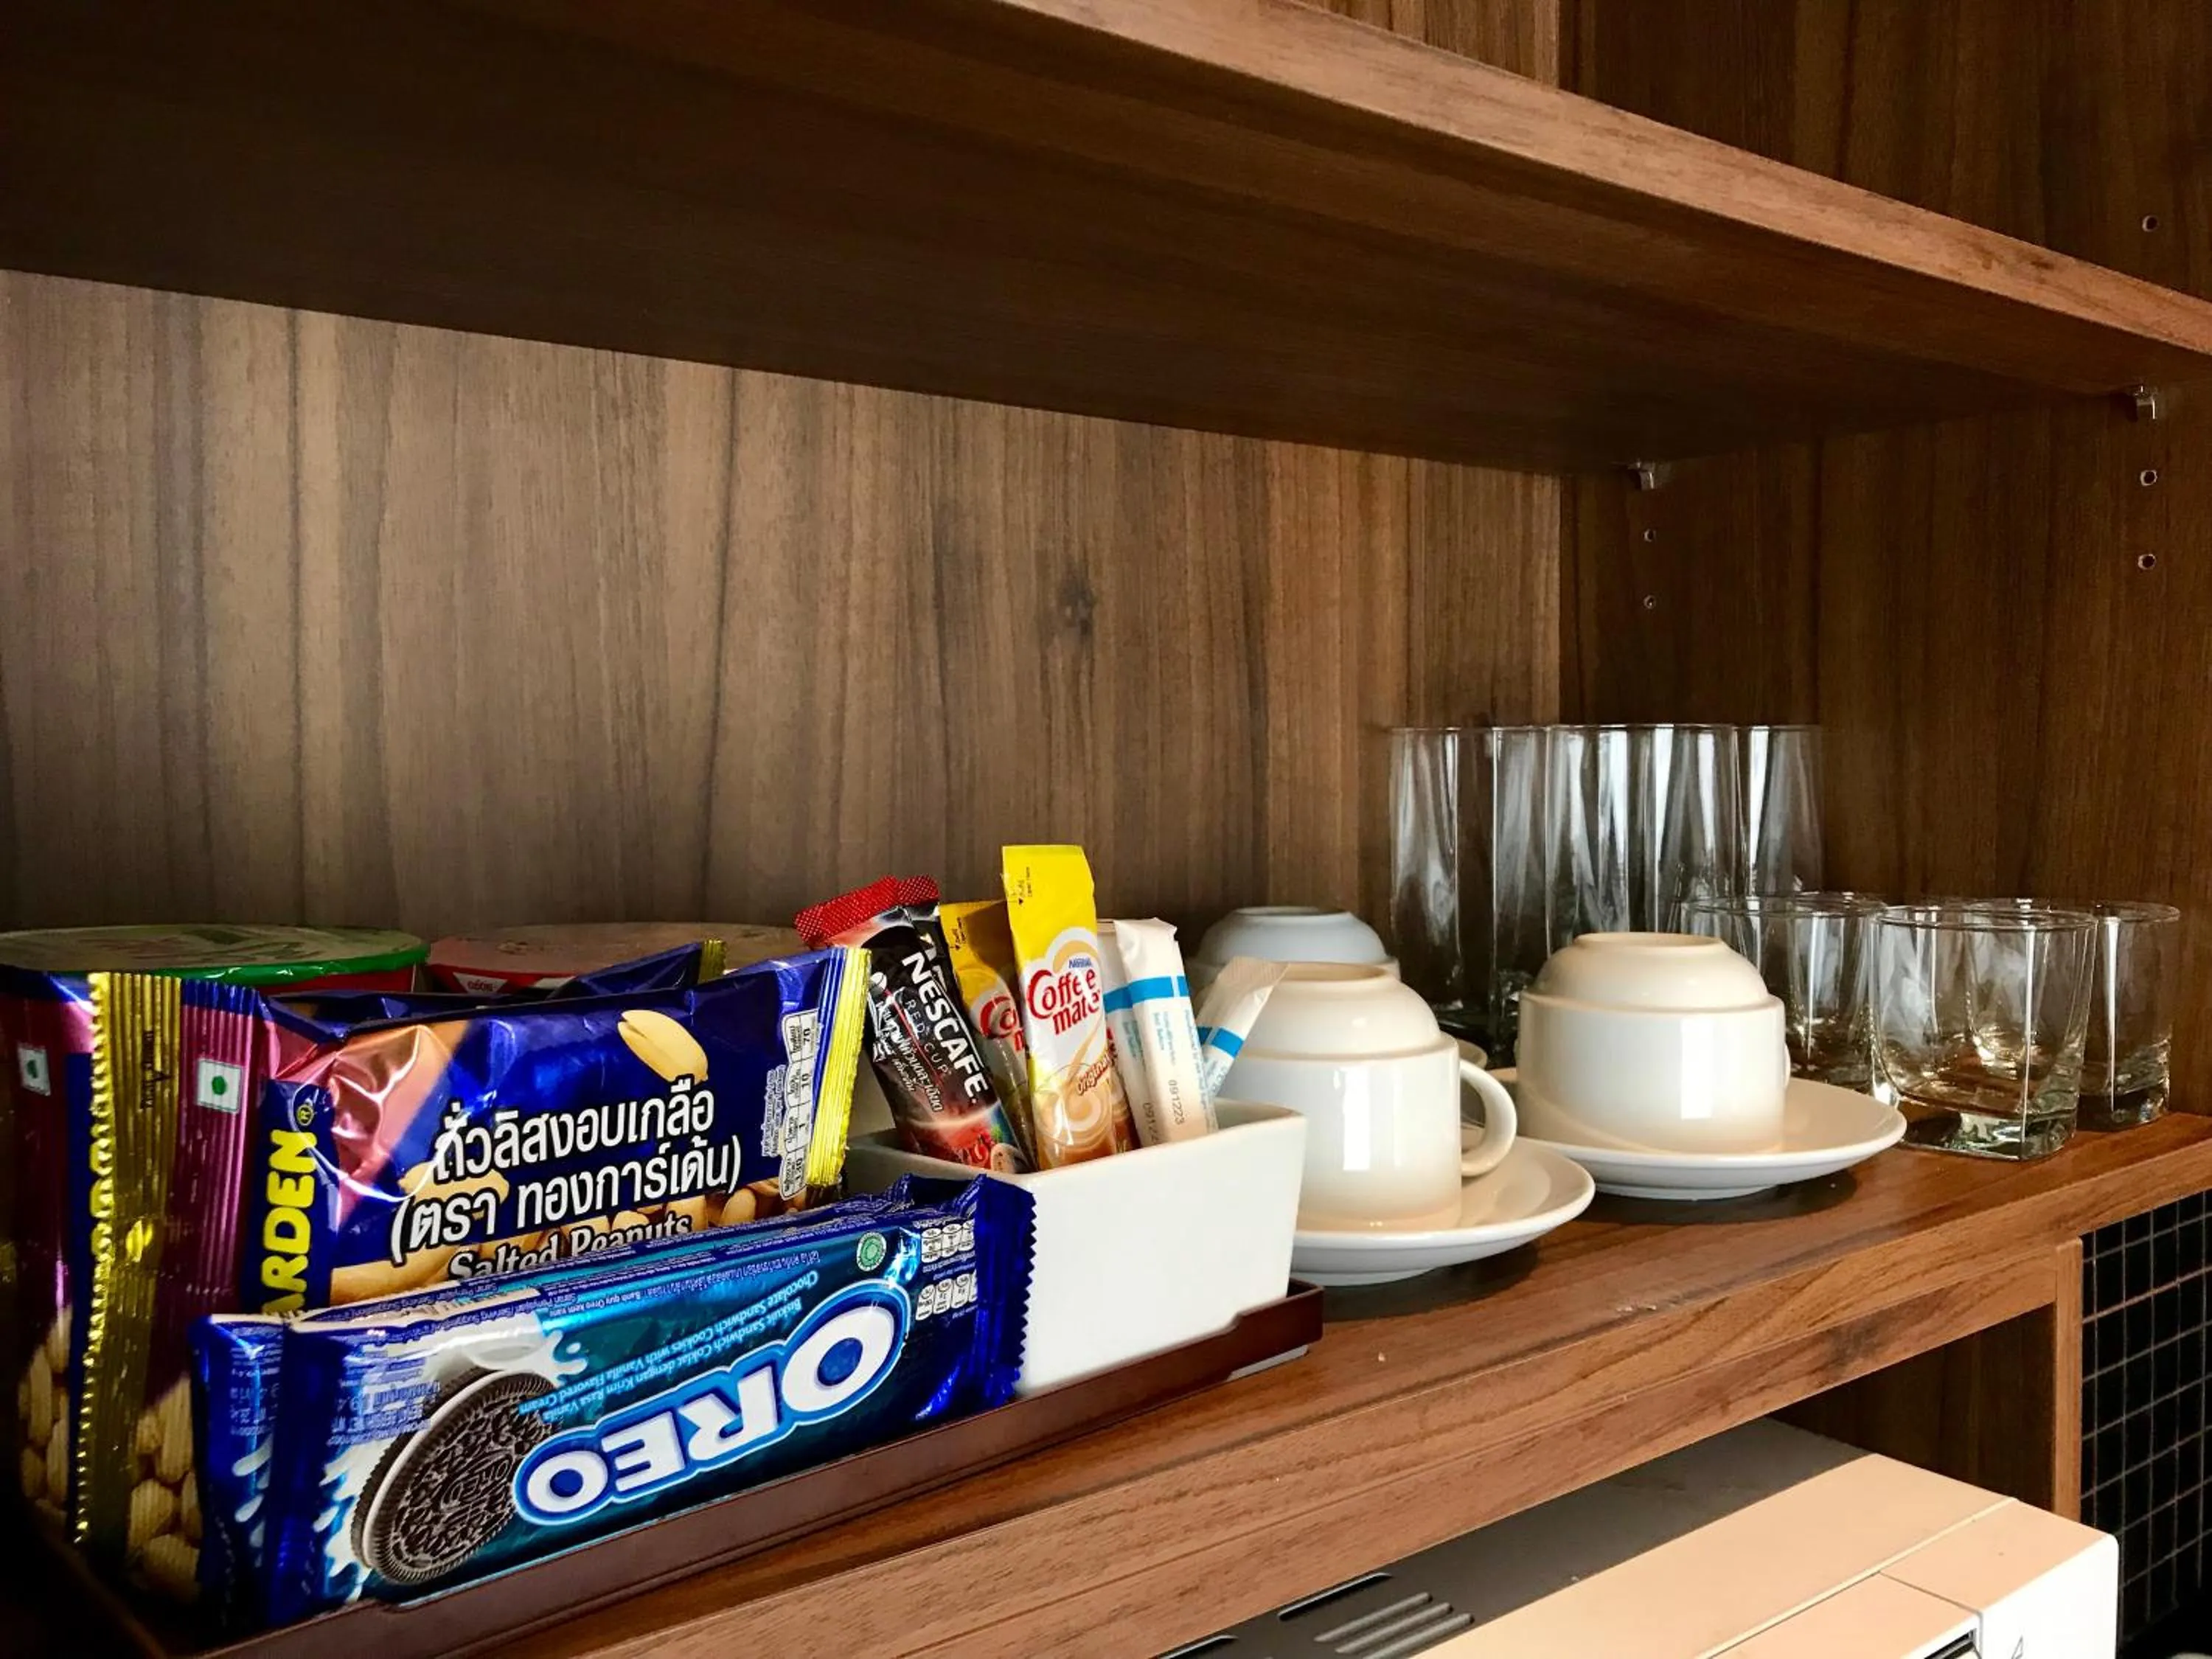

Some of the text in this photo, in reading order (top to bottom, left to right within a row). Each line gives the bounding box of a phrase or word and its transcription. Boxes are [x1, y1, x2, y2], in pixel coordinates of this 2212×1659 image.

[1026, 968, 1096, 1020] Coffee
[1052, 990, 1100, 1035] mate
[802, 1027, 811, 1043] 70
[905, 999, 949, 1075] RED CUP
[801, 1072, 810, 1088] 10
[1168, 1079, 1186, 1126] 091223
[434, 1078, 714, 1180] ถั่วลิสงอบเกลือ
[1144, 1102, 1162, 1146] 09122
[391, 1190, 496, 1265] (ตรา
[517, 1135, 742, 1230] ทองการ์เด้น)
[262, 1130, 318, 1315] ARDEN
[449, 1235, 558, 1280] Salted
[570, 1212, 691, 1256] Peanuts
[766, 1270, 820, 1307] Chocolate
[714, 1301, 768, 1336] Sandwich
[767, 1296, 804, 1326] Biskuit
[672, 1326, 714, 1354] Cookies
[713, 1317, 767, 1352] Sandwich
[606, 1357, 645, 1381] Vanilla
[636, 1358, 677, 1383] dengan
[644, 1343, 670, 1364] with
[676, 1343, 713, 1368] Coklat
[558, 1371, 606, 1399] Flavored
[580, 1387, 605, 1406] Rasa
[606, 1380, 635, 1395] Krim
[519, 1392, 560, 1416] Cream
[526, 1294, 894, 1514] OREO
